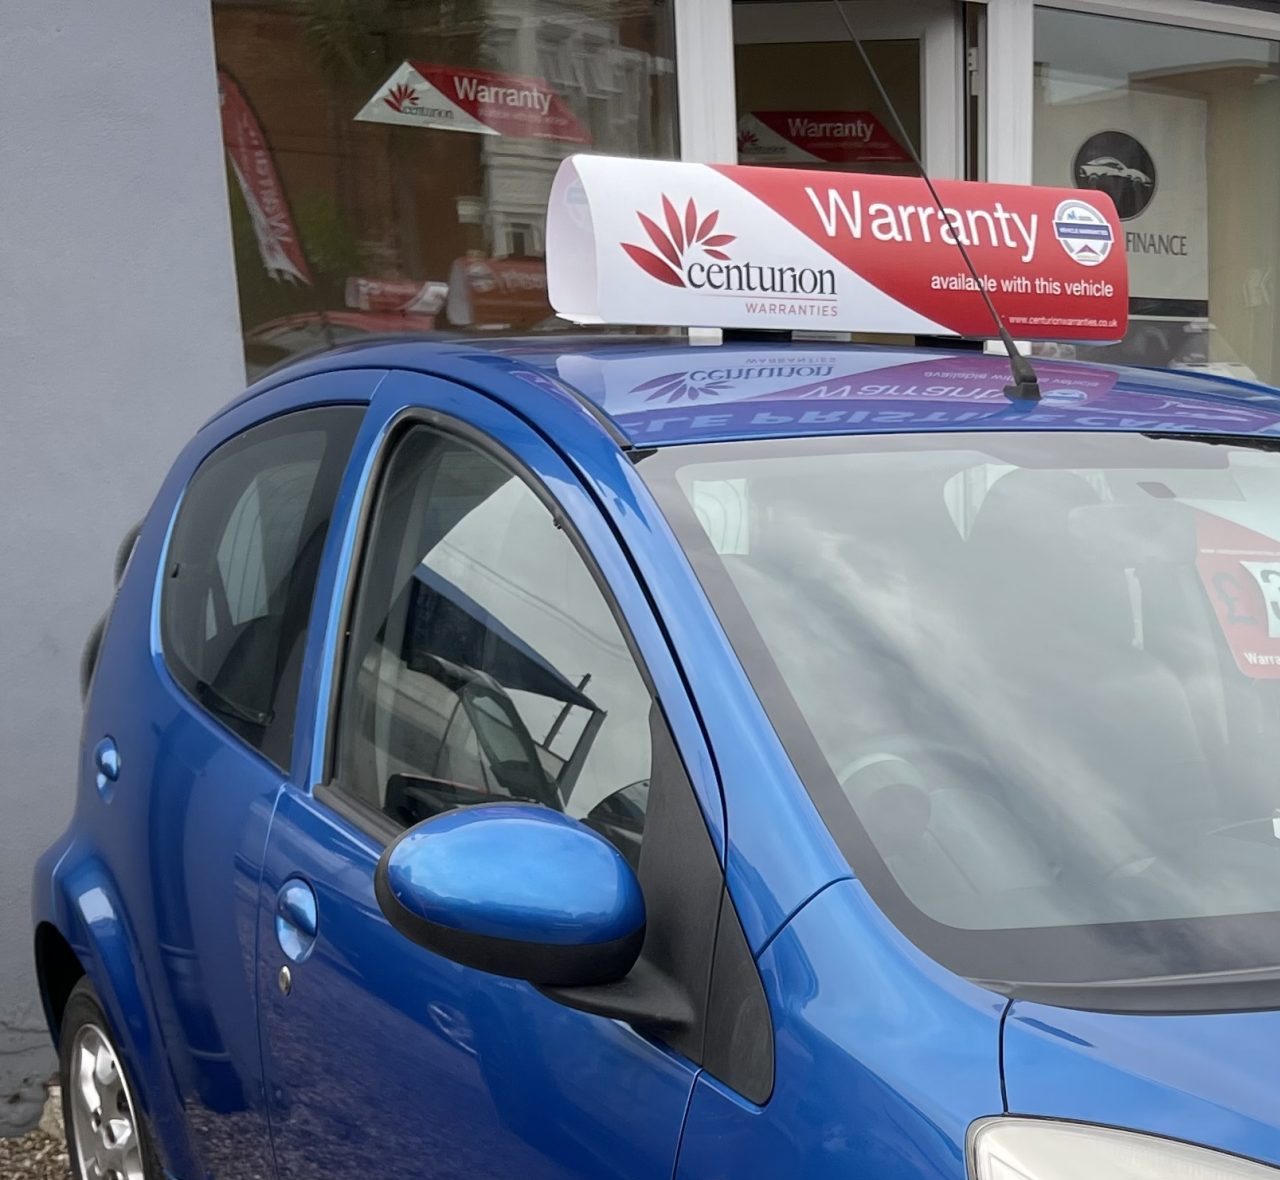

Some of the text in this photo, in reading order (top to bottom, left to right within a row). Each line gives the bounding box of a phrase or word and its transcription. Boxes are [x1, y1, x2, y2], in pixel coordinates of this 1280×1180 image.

[454, 76, 552, 115] Warranty
[788, 118, 874, 142] Warranty
[805, 186, 1038, 263] Warranty
[1126, 232, 1188, 256] FINANCE
[687, 261, 838, 295] centurion
[931, 273, 1114, 297] available with this vehicle
[745, 303, 838, 317] WARRANTIES
